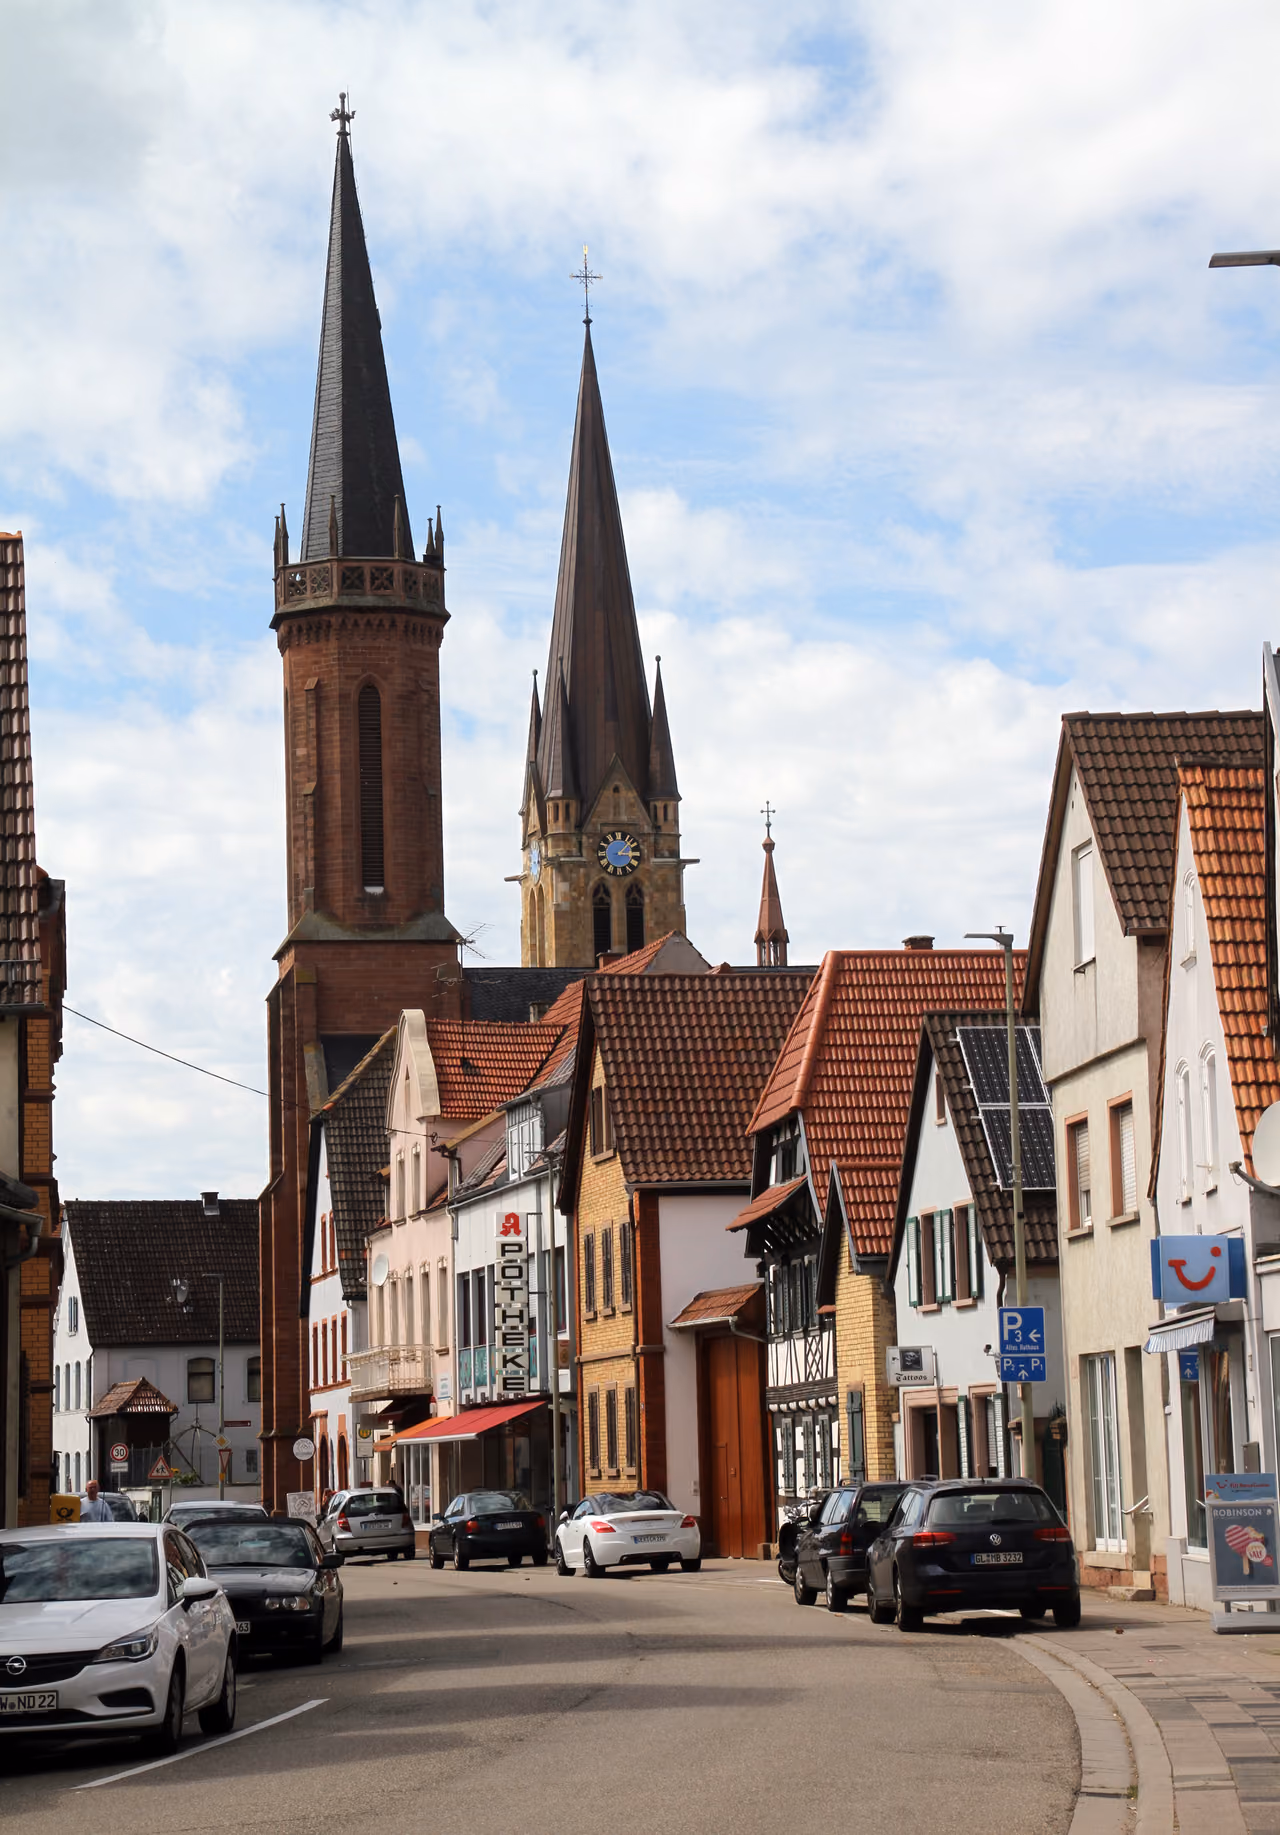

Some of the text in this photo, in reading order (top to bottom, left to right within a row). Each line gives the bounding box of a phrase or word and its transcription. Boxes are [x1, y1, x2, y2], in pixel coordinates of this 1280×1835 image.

[114, 1448, 125, 1457] 30
[1213, 1508, 1262, 1517] ROBINSON
[18, 1696, 35, 1709] ND
[38, 1694, 55, 1708] 22
